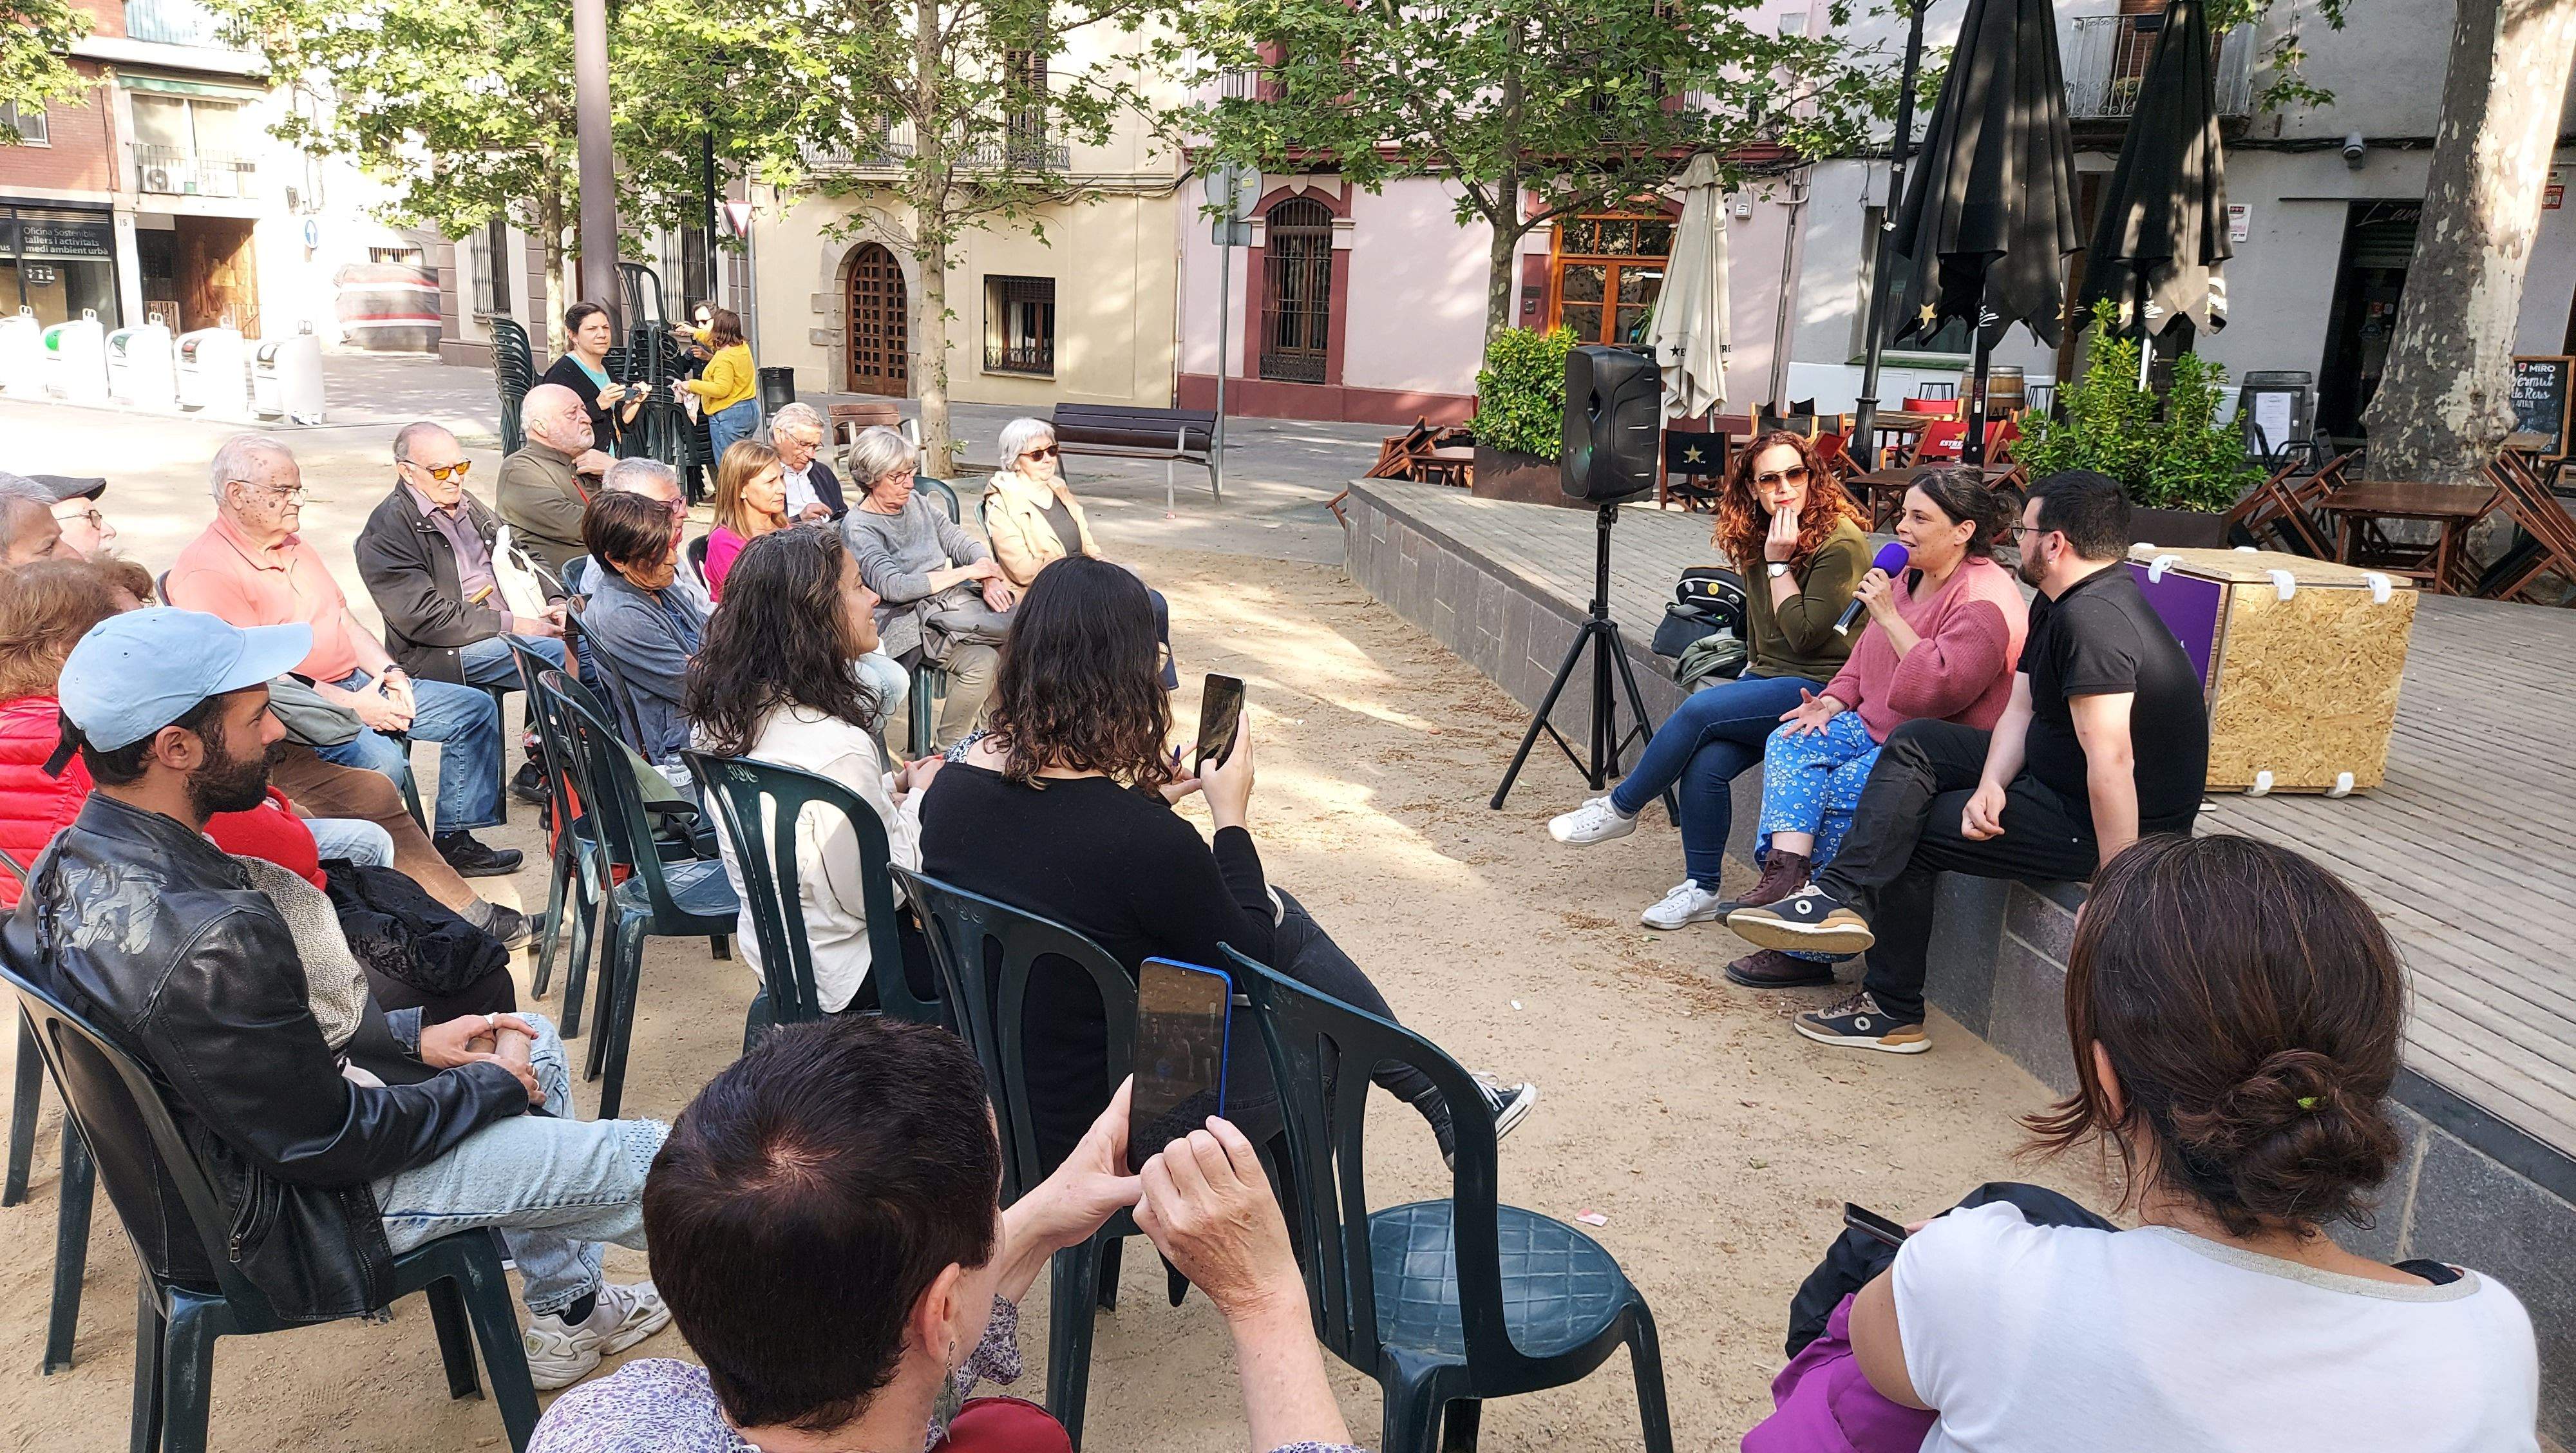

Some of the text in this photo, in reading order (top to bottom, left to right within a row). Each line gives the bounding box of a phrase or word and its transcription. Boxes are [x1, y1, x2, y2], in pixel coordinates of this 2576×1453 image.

[23, 227, 52, 236] Oficina
[59, 238, 100, 247] activitats
[50, 246, 87, 254] ambient
[88, 247, 108, 255] urbà
